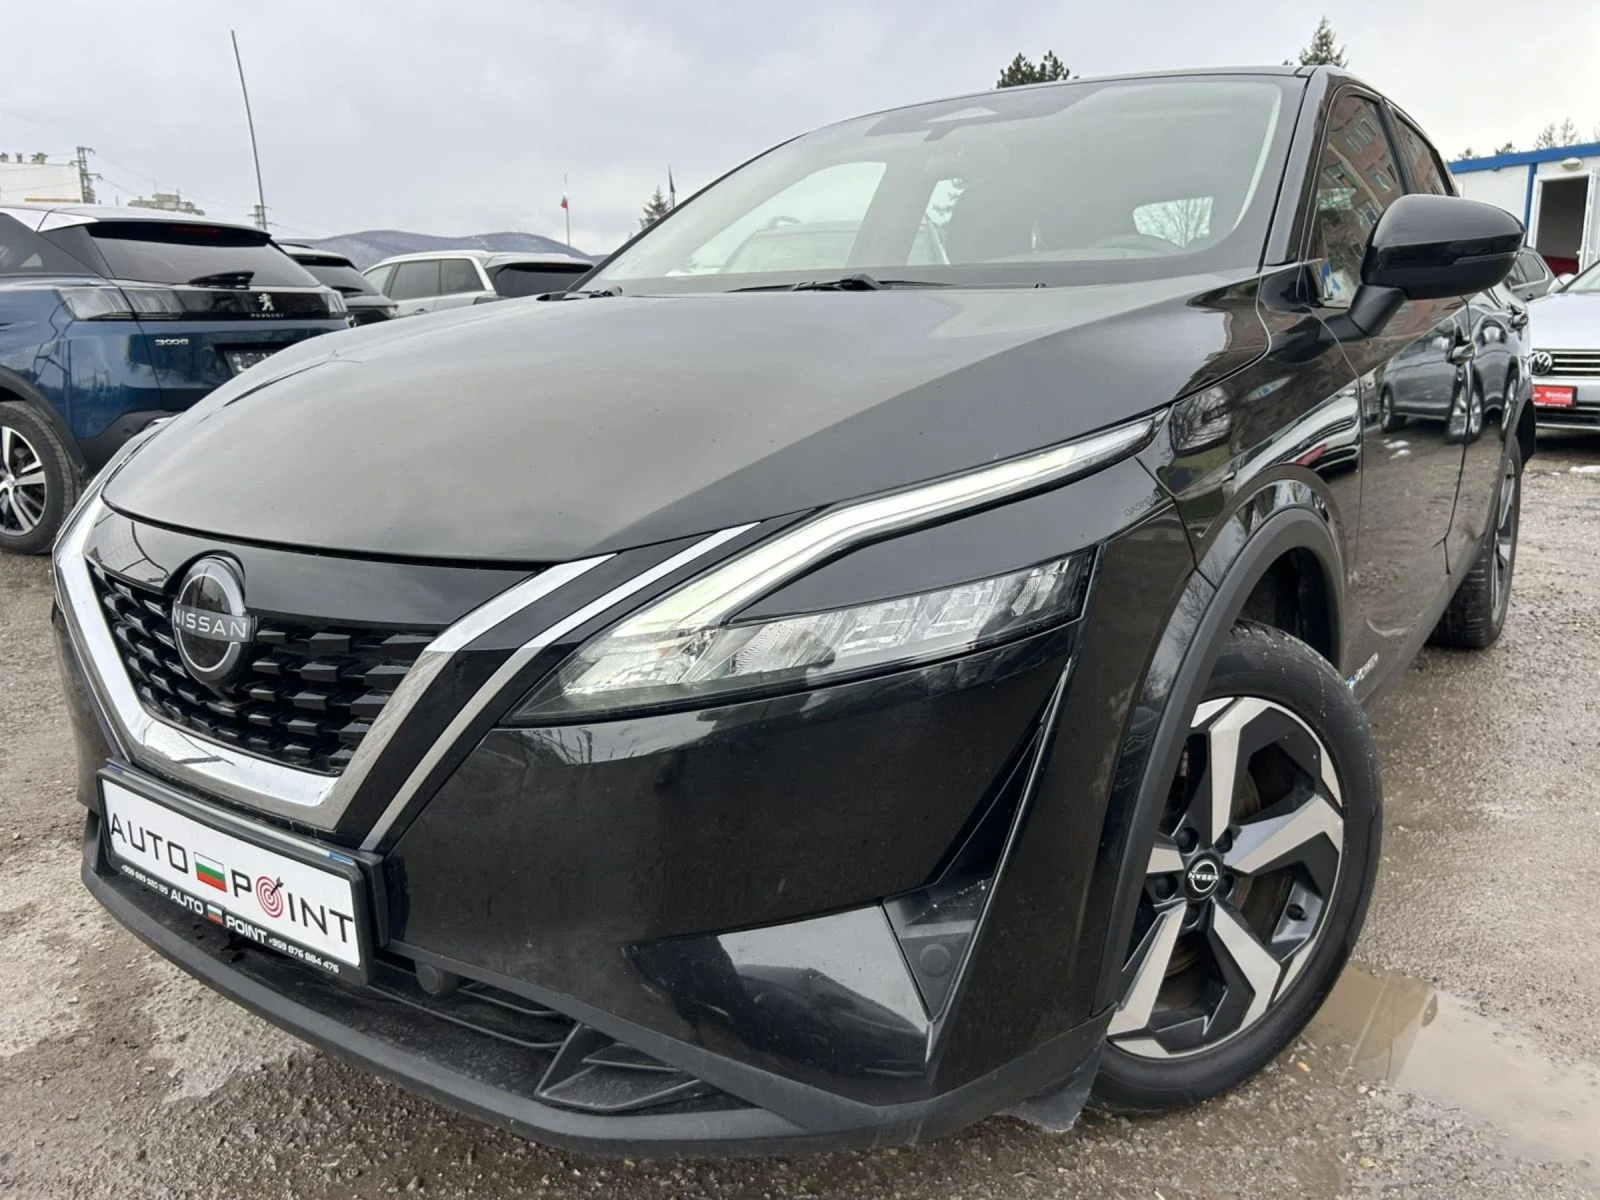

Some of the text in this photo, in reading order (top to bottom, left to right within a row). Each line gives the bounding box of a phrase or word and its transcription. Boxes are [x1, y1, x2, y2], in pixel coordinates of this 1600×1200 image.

[154, 338, 190, 346] 3008
[172, 605, 247, 638] NISSAN
[110, 812, 190, 875] AUTO
[170, 889, 204, 915] AUTO
[225, 915, 267, 944] POINT
